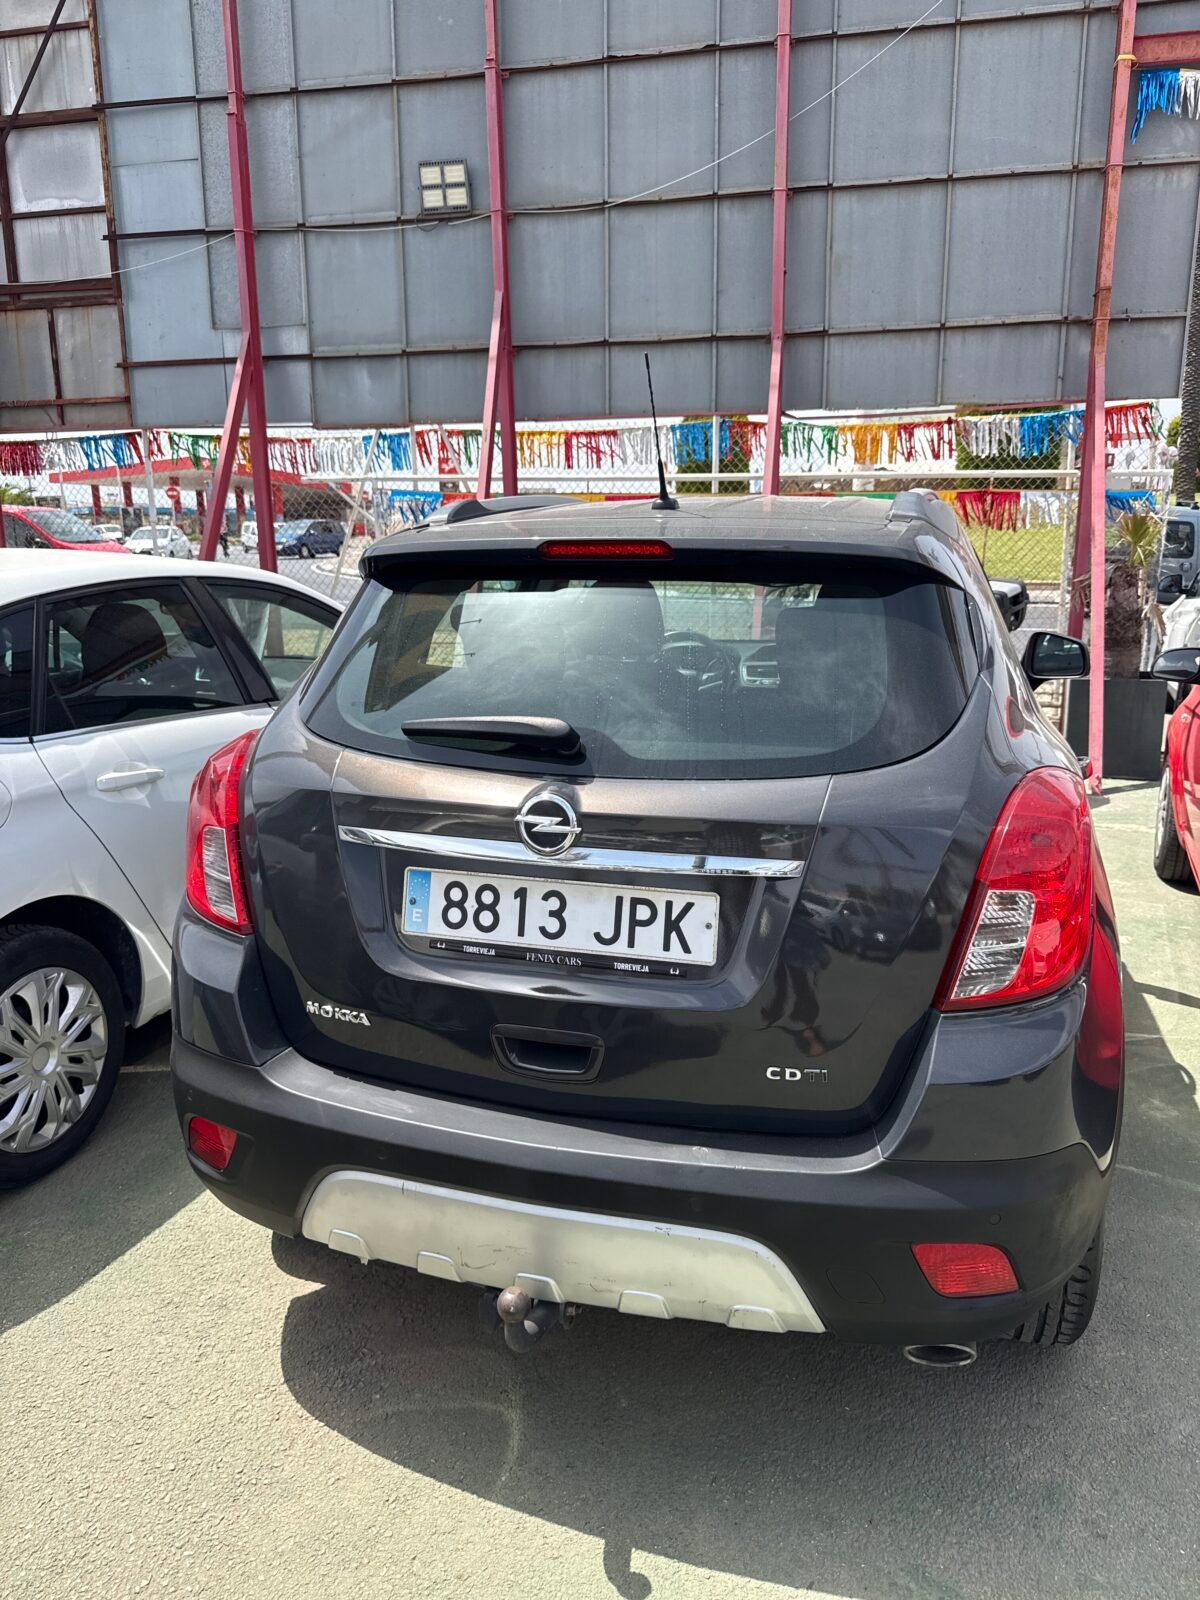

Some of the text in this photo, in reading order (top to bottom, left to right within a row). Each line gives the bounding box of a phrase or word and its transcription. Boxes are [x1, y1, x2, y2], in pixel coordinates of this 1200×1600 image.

[412, 908, 423, 922] E
[441, 880, 695, 954] 8813 JPK
[463, 945, 496, 956] TORREVIEJA
[526, 952, 582, 967] FENIX CARS
[613, 962, 650, 973] TORREVIEJA
[306, 1001, 371, 1026] MOKKA
